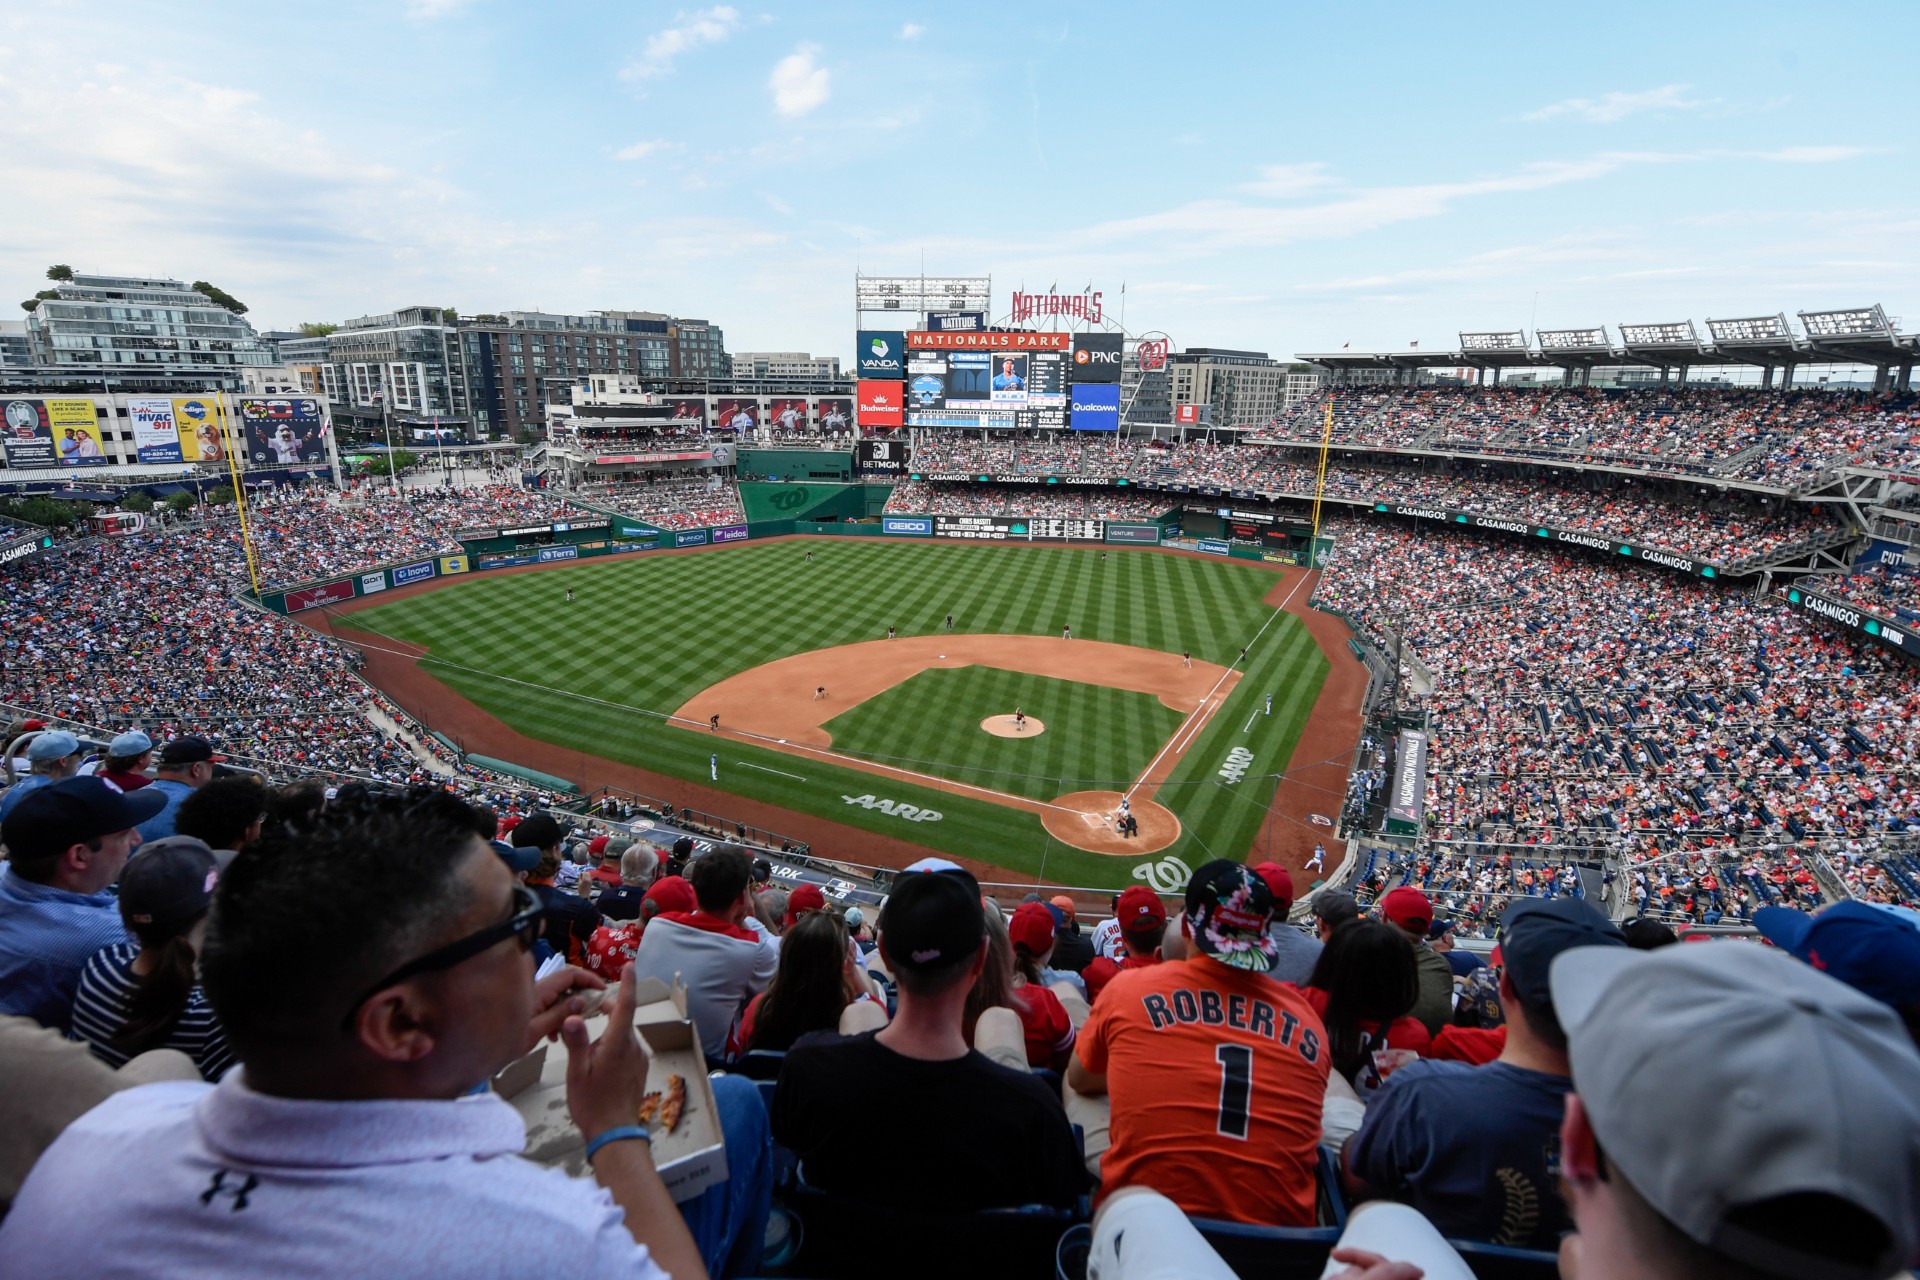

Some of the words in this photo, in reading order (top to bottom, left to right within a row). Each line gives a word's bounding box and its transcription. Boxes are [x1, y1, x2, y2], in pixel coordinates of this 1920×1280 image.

[1012, 291, 1102, 324] NATIONALS
[941, 316, 977, 329] NATITUDE
[913, 335, 1009, 346] NATIONALS
[1017, 336, 1060, 346] PARK
[1091, 351, 1120, 363] PNC
[861, 359, 899, 367] VANDA
[860, 404, 900, 412] Budweiser
[1072, 402, 1117, 412] Qualcomm
[138, 413, 171, 421] HVAC
[153, 421, 171, 429] 911
[862, 460, 900, 469] BETMGM
[996, 475, 1039, 483] CASAMIGOS
[1066, 477, 1109, 485] CASAMIGOS
[888, 522, 925, 531] GEICO
[724, 530, 747, 538] leidos
[1396, 506, 1446, 520] CASAMIGOS
[1476, 517, 1528, 534] CASAMIGOS
[1558, 531, 1610, 551] CASAMIGOS
[1642, 549, 1692, 572] CASAMIGOS
[551, 550, 575, 558] Terra
[407, 565, 430, 575] Inova
[363, 575, 383, 584] GDIT
[303, 594, 339, 608] Budweiser
[1804, 595, 1860, 627] CASAMIGOS
[1404, 739, 1420, 766] NATIONALS
[1218, 746, 1255, 784] AARP
[1400, 765, 1417, 806] WASHINGTON
[840, 794, 943, 822] AARP
[1142, 988, 1320, 1064] ROBERTS
[1215, 1042, 1253, 1141] 1
